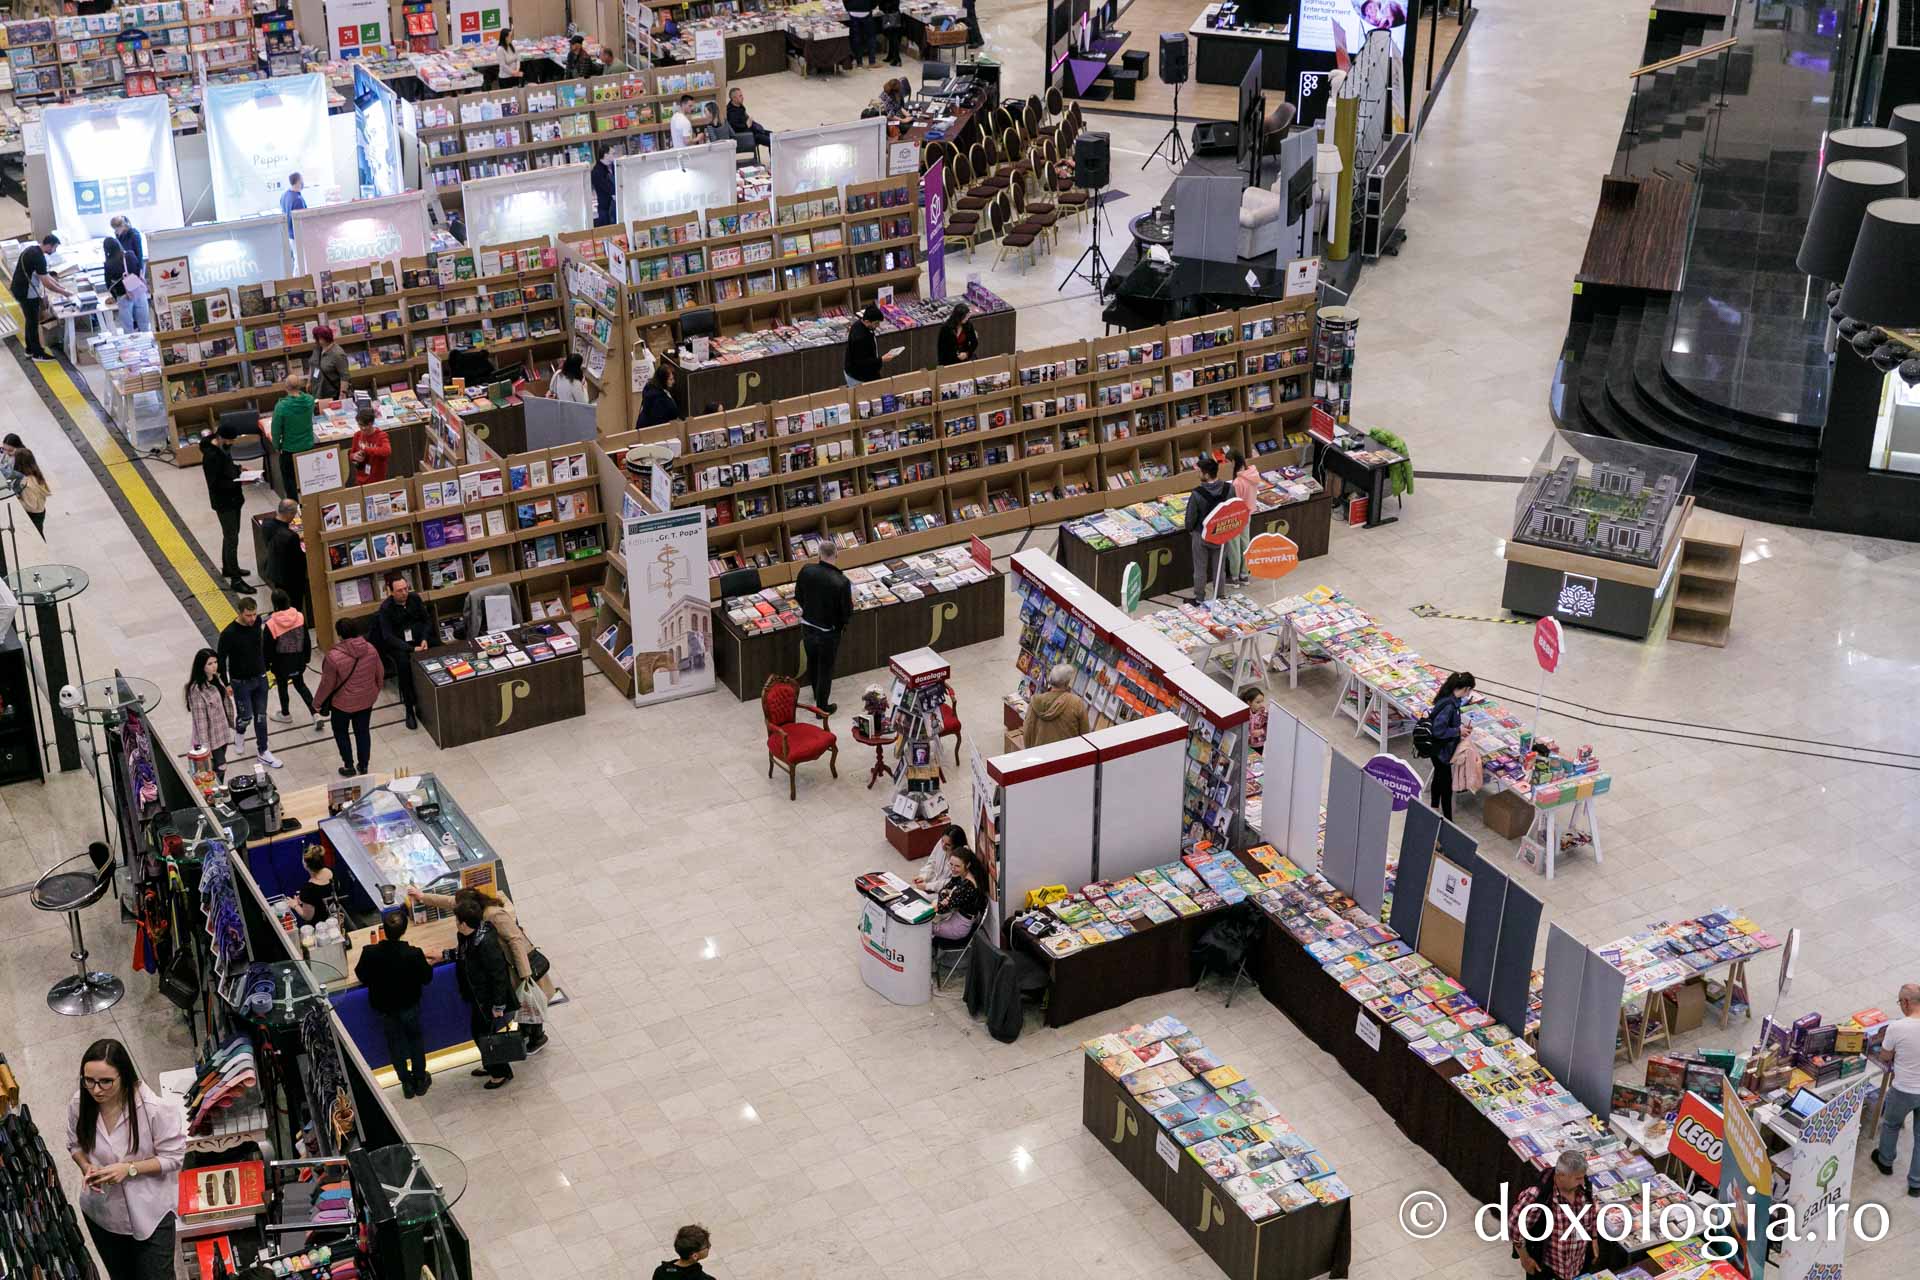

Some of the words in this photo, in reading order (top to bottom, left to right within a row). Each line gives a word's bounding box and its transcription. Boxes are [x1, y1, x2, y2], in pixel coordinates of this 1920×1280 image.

[914, 670, 948, 684] doxologia
[1677, 1116, 1723, 1162] LEGO
[1801, 1186, 1842, 1229] gama
